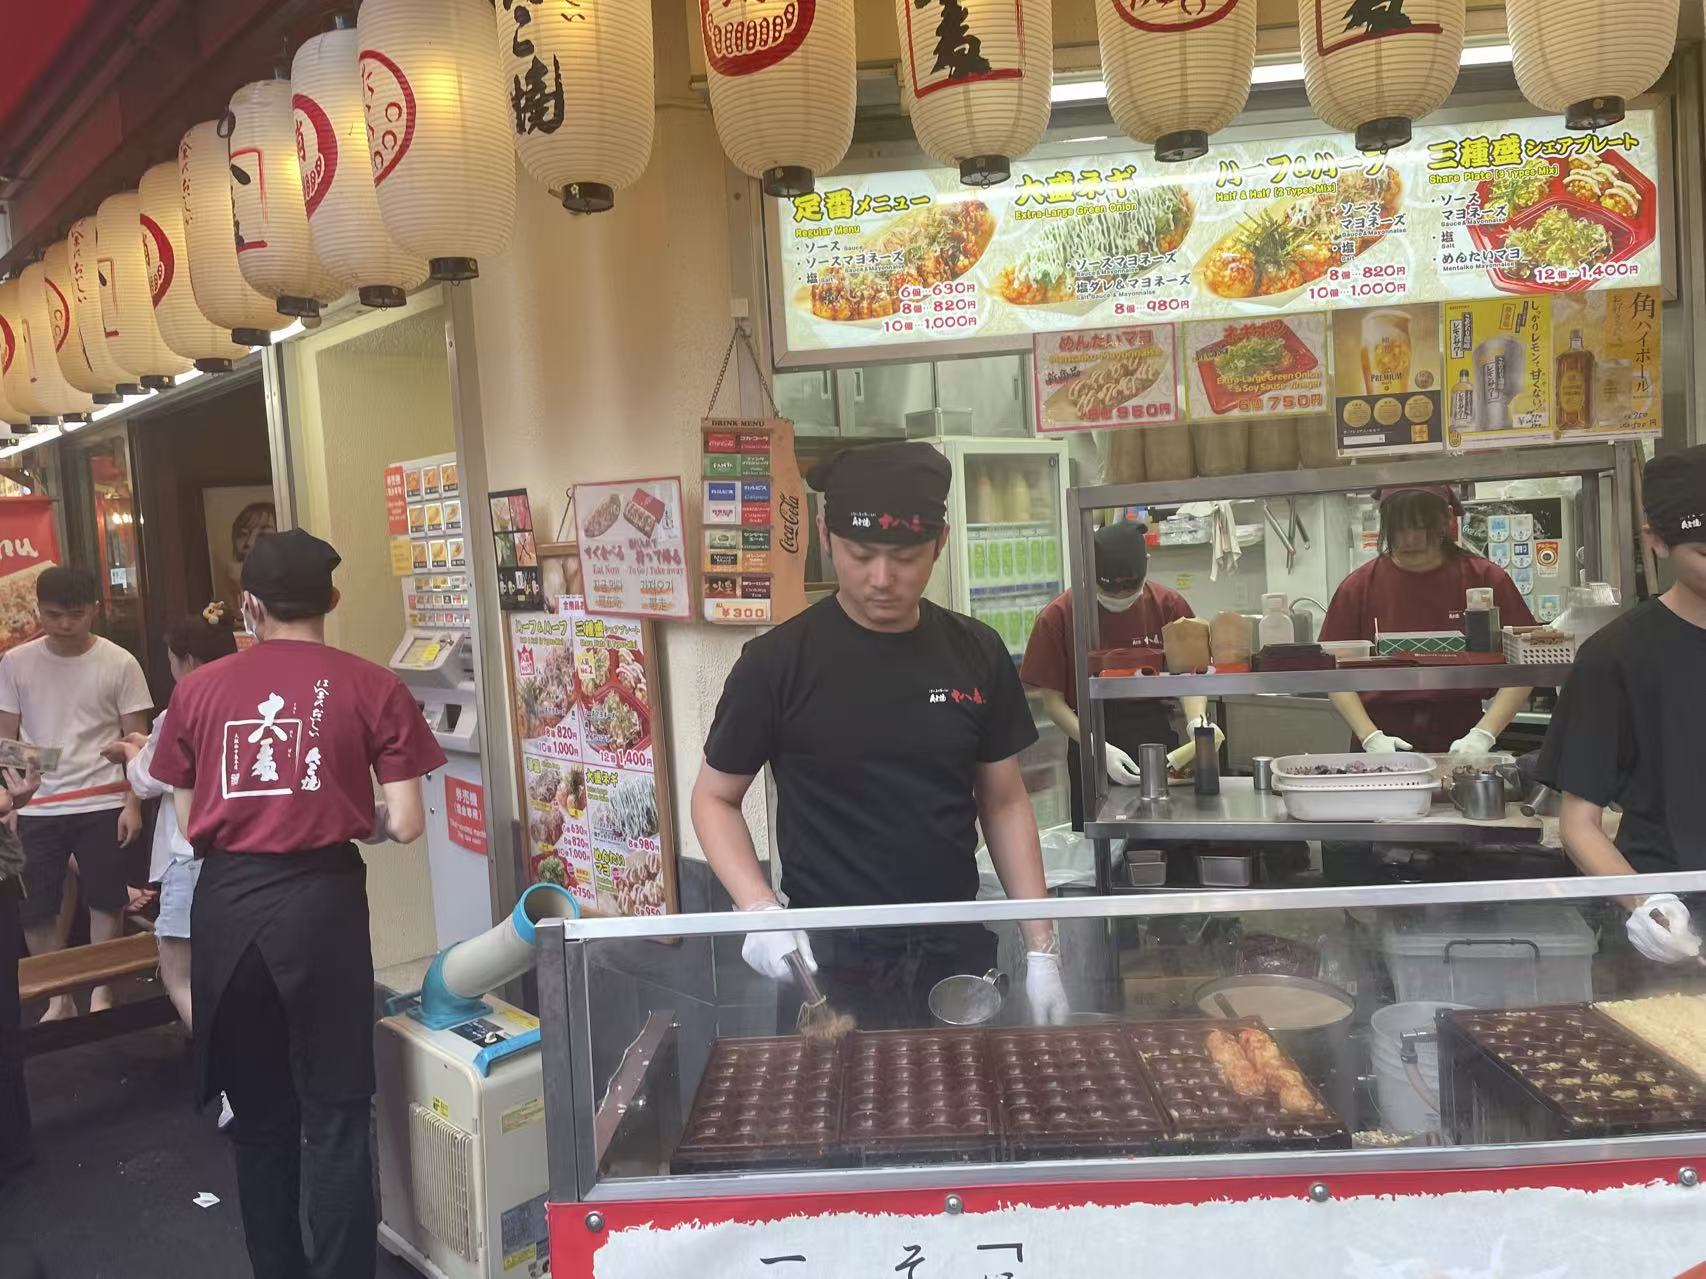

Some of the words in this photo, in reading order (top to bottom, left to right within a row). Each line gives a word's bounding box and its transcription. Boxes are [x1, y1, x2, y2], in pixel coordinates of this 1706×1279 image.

[503, 0, 565, 135] こ焼
[1429, 173, 1460, 184] Share
[1463, 171, 1491, 181] Plate
[1015, 165, 1137, 206] 大盛ネギ
[1216, 191, 1238, 202] Half
[1250, 189, 1271, 198] Half
[1441, 192, 1480, 206] ソース
[792, 187, 931, 223] 定番メニュー
[1076, 205, 1105, 215] Green
[1109, 202, 1137, 211] Onion
[1341, 202, 1381, 216] ソース
[1441, 205, 1508, 220] マヨネーズ
[1341, 213, 1406, 230] マヨネーズ
[795, 228, 832, 239] Regular
[834, 225, 860, 235] Menu
[1441, 231, 1454, 243] 塩
[805, 240, 840, 253] ソース
[1341, 242, 1354, 254] 塩
[806, 251, 904, 269] ソースマヨネーズ
[1076, 252, 1177, 270] ソースマヨネーズ
[1442, 248, 1521, 264] めんたいマヨ
[806, 272, 818, 284] 塩
[1632, 291, 1655, 392] 角ハイボール
[1243, 384, 1258, 393] Soy
[779, 491, 799, 554] Coca-Cola
[593, 564, 604, 575] Eat
[605, 565, 620, 574] Now
[722, 607, 765, 618] ¥300
